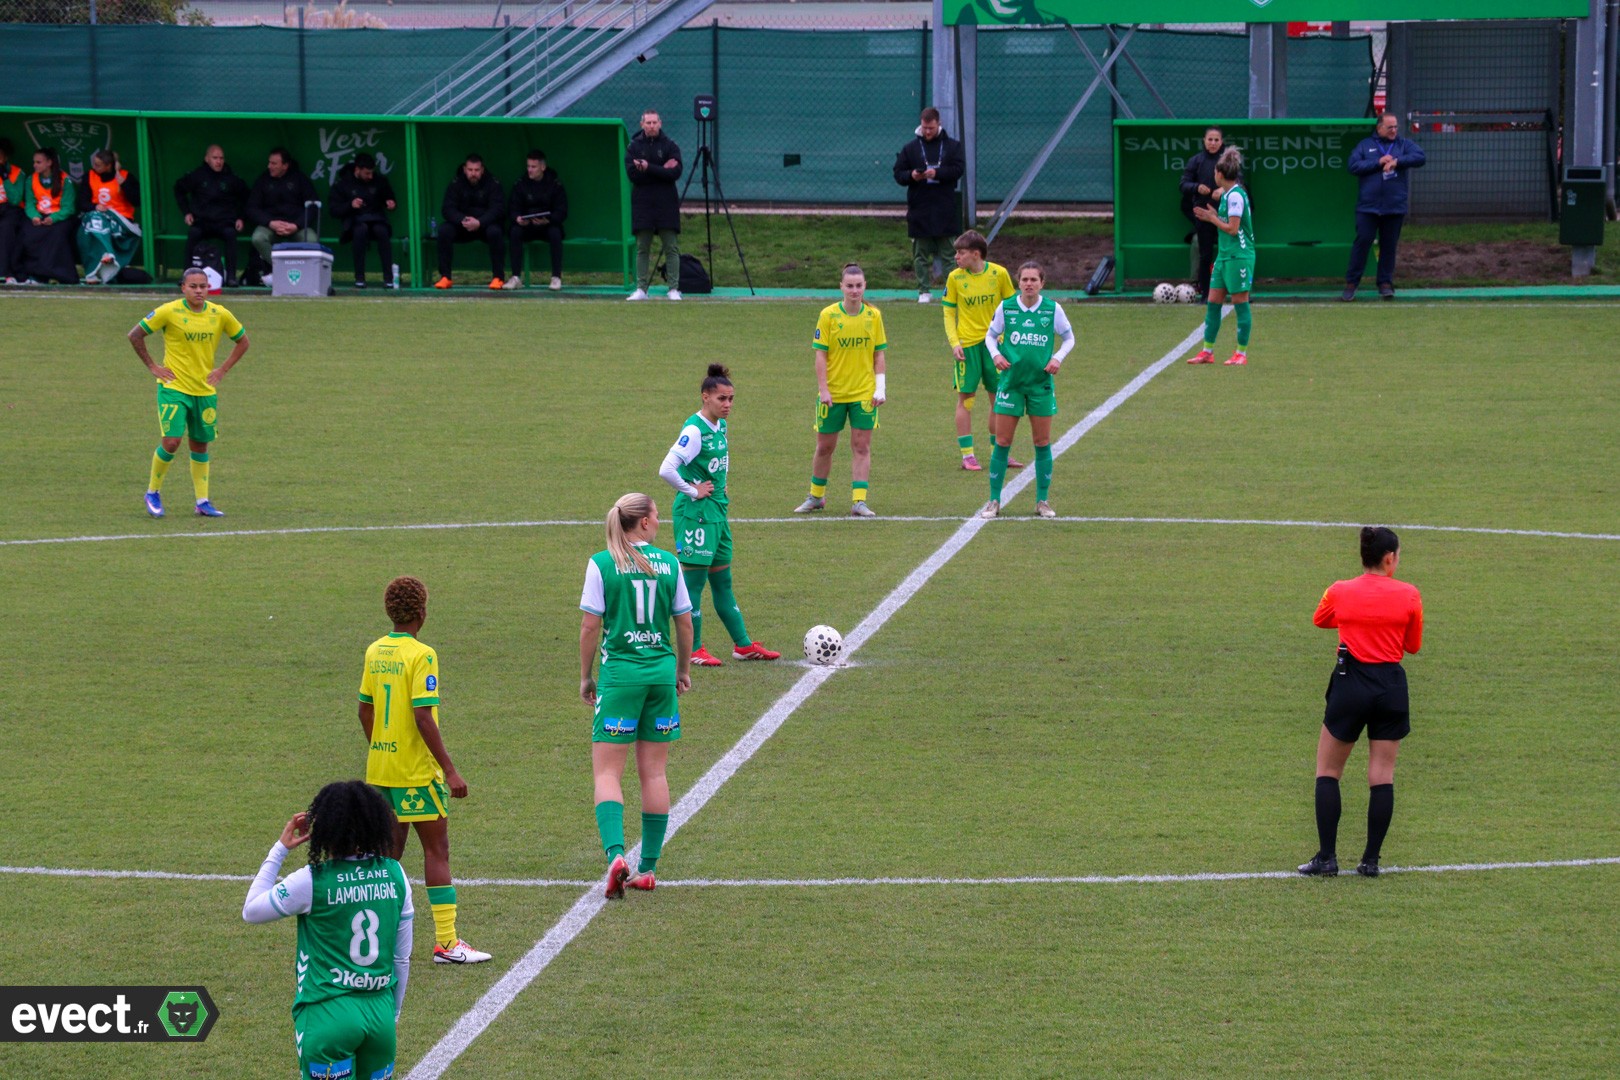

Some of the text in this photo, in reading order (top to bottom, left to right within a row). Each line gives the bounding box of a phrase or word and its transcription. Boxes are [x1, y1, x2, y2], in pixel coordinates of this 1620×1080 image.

[36, 122, 101, 136] ASSE
[318, 127, 388, 153] Vert
[324, 148, 395, 187] Fr
[1242, 152, 1343, 174] tropole
[964, 293, 996, 306] WIPT
[184, 332, 215, 341] WIPT
[838, 337, 871, 348] WIPT
[1020, 332, 1049, 343] AESIO
[959, 360, 967, 377] 9
[161, 403, 179, 421] 77
[694, 527, 705, 547] 9
[631, 579, 658, 624] 11
[336, 865, 389, 882] SILÉANE
[326, 882, 398, 905] LAMONTAGNE
[350, 908, 380, 967] 8
